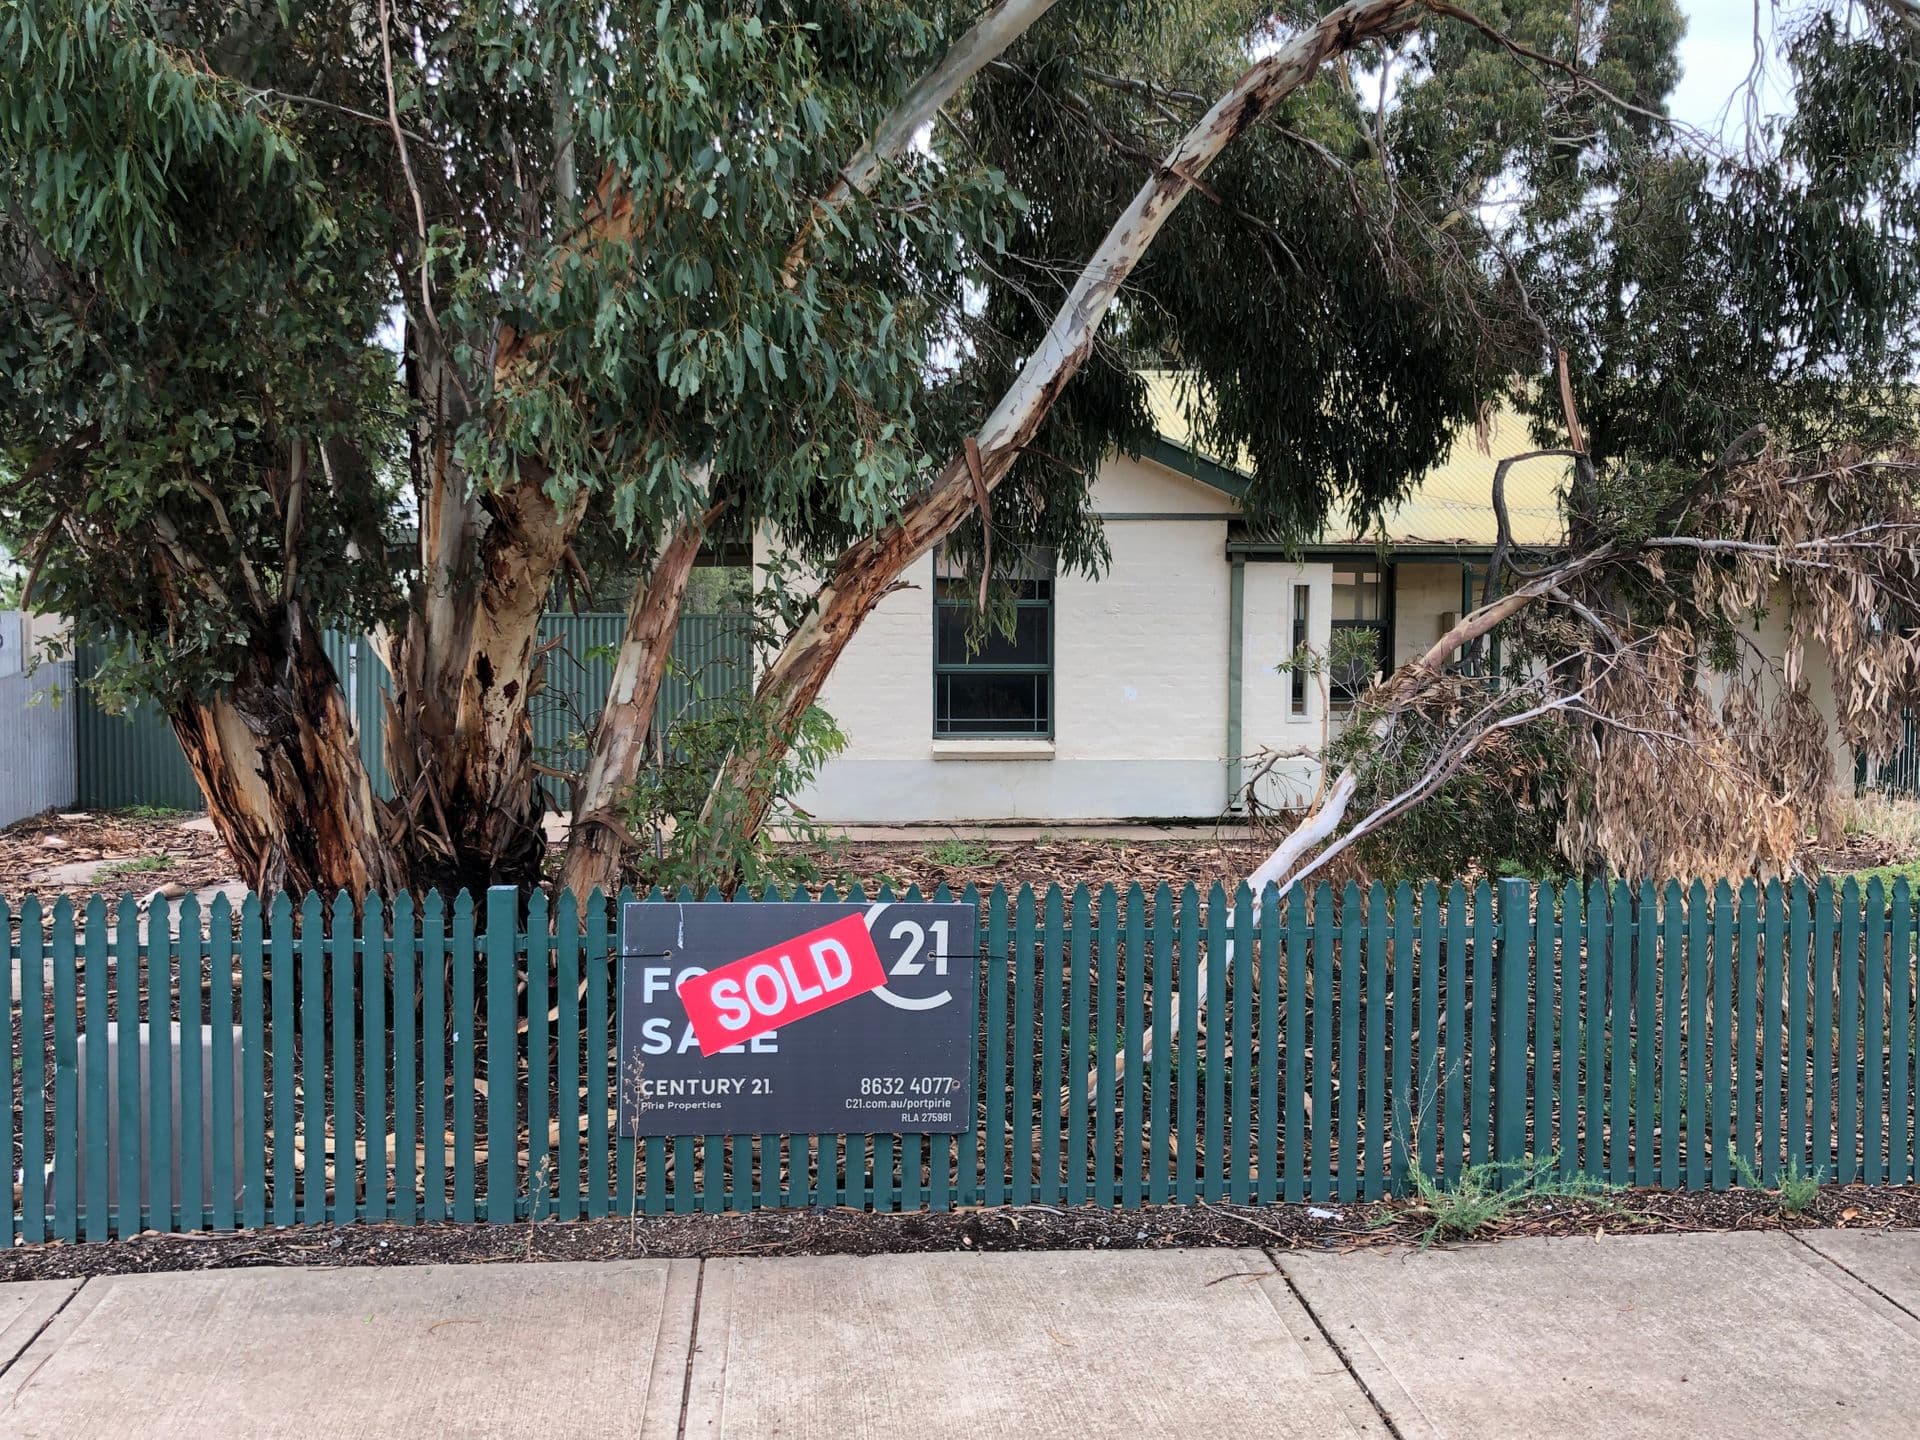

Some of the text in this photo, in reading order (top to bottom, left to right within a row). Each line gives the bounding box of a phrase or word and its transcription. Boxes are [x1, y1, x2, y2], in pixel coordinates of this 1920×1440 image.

[710, 938, 852, 1032] SOLD
[641, 1078, 746, 1096] CENTURY
[861, 1077, 953, 1095] 8632 4077
[640, 1100, 722, 1111] Pirie Properties
[845, 1098, 952, 1110] C21.com.au/portpirie
[901, 1112, 952, 1123] RLA 275981
